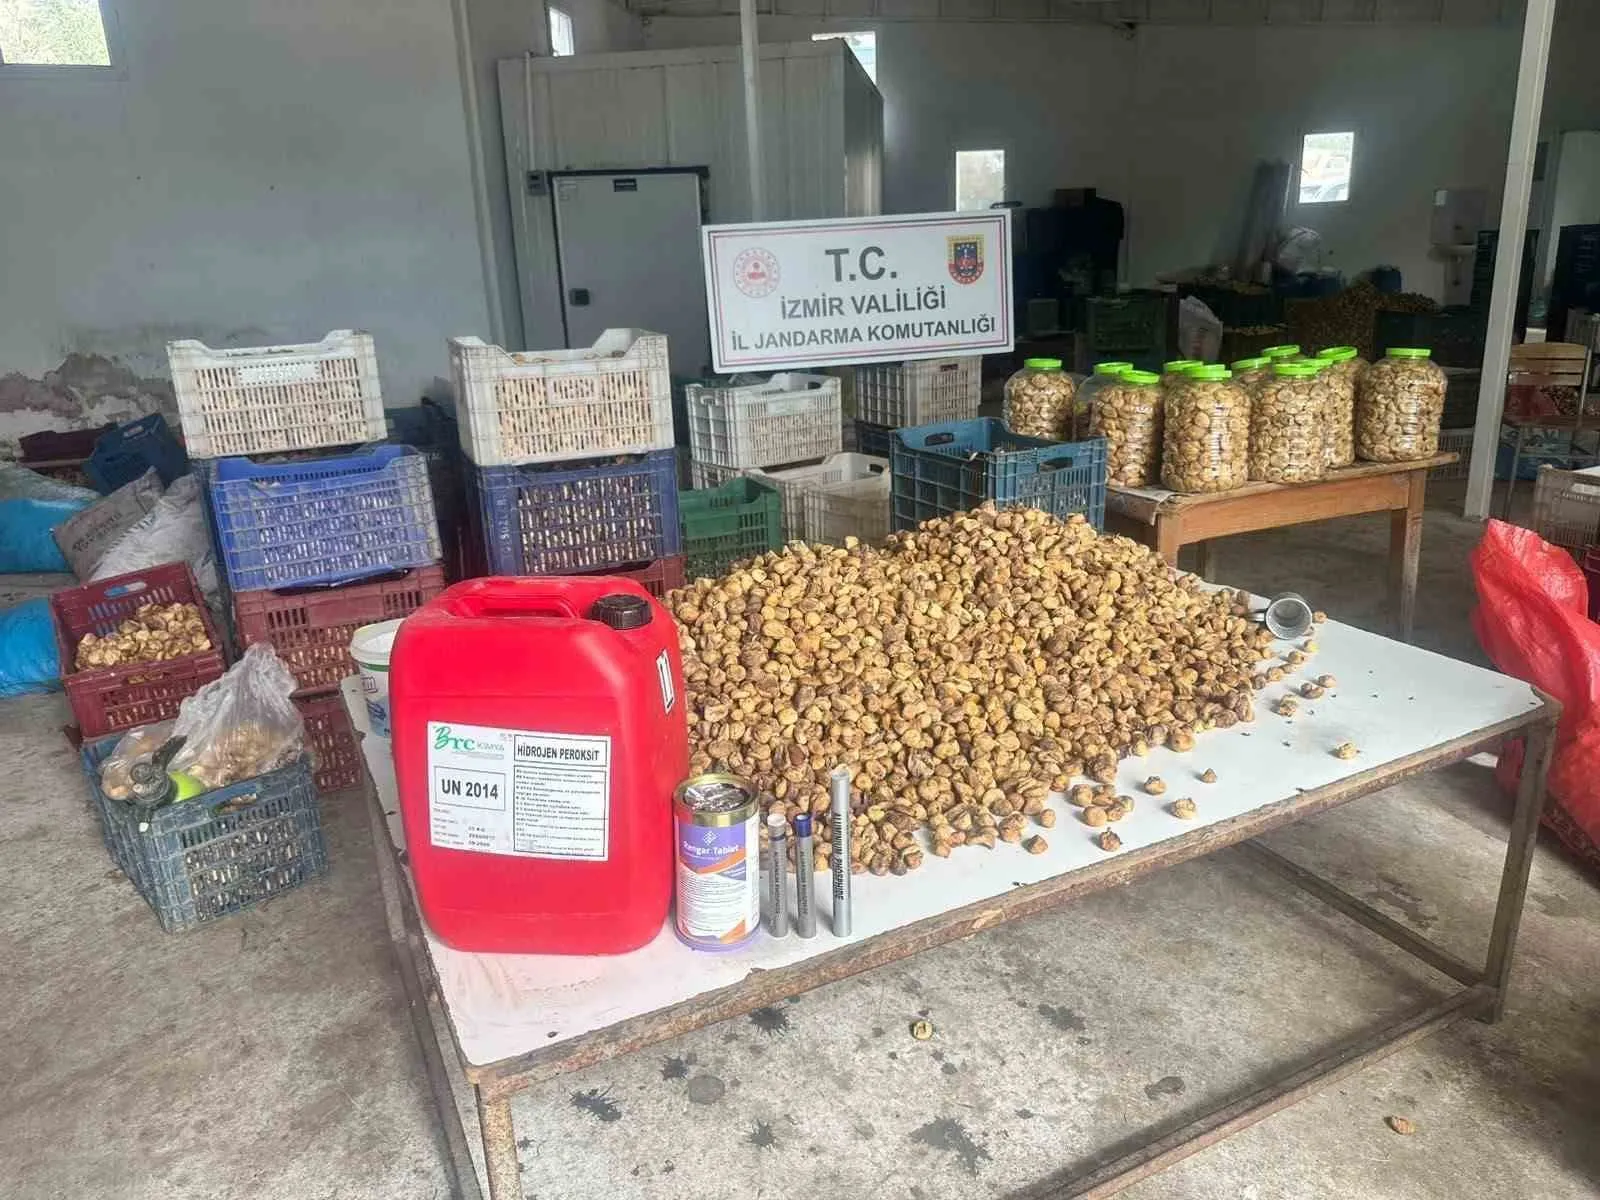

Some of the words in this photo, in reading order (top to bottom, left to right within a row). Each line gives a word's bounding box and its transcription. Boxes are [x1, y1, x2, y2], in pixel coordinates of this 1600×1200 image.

[825, 246, 897, 282] T.C.
[780, 292, 845, 320] İZMİR
[851, 285, 946, 314] VALİLİĞİ
[732, 330, 749, 351] İL
[755, 326, 863, 350] JANDARMA
[867, 313, 995, 342] KOMUTANLIĞI
[517, 742, 557, 759] HİDROJEN
[559, 747, 600, 762] PEROKSİT
[441, 778, 462, 796] UN
[465, 781, 499, 800] 2014
